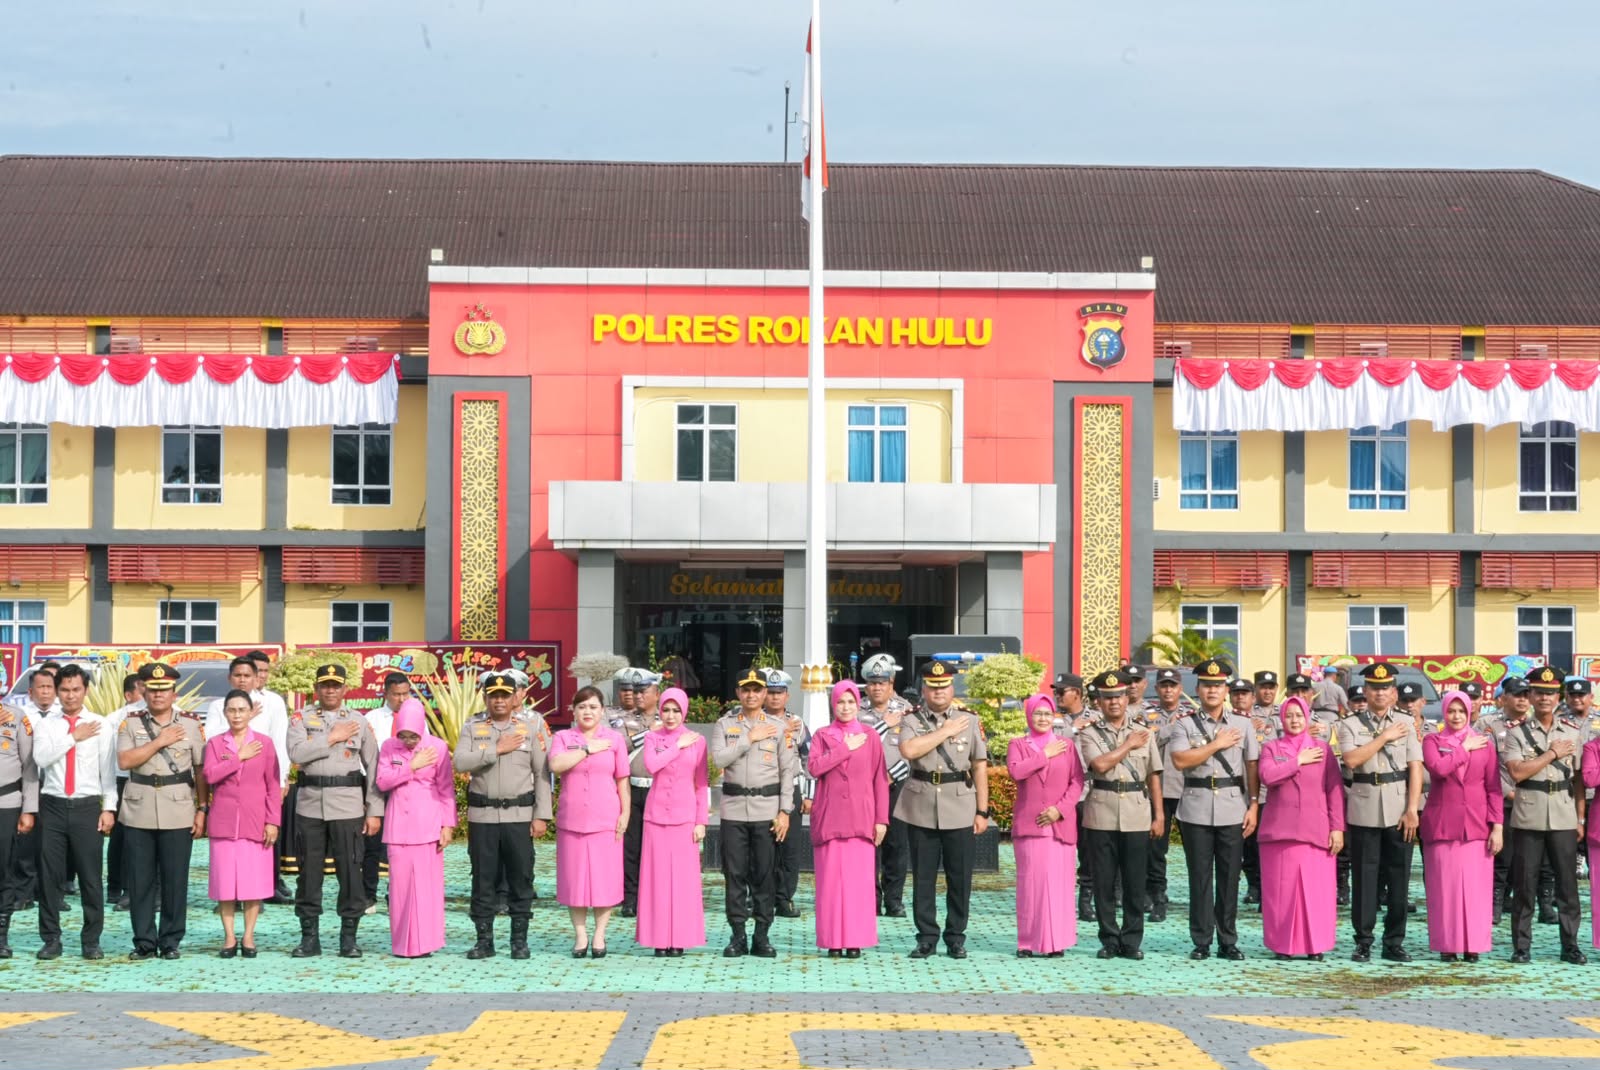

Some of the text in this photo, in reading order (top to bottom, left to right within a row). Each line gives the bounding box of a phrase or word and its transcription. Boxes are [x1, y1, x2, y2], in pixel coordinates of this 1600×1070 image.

[1085, 304, 1123, 313] RIAU
[593, 314, 741, 343] POLRES
[891, 317, 992, 346] HULU
[442, 646, 501, 671] Sukses
